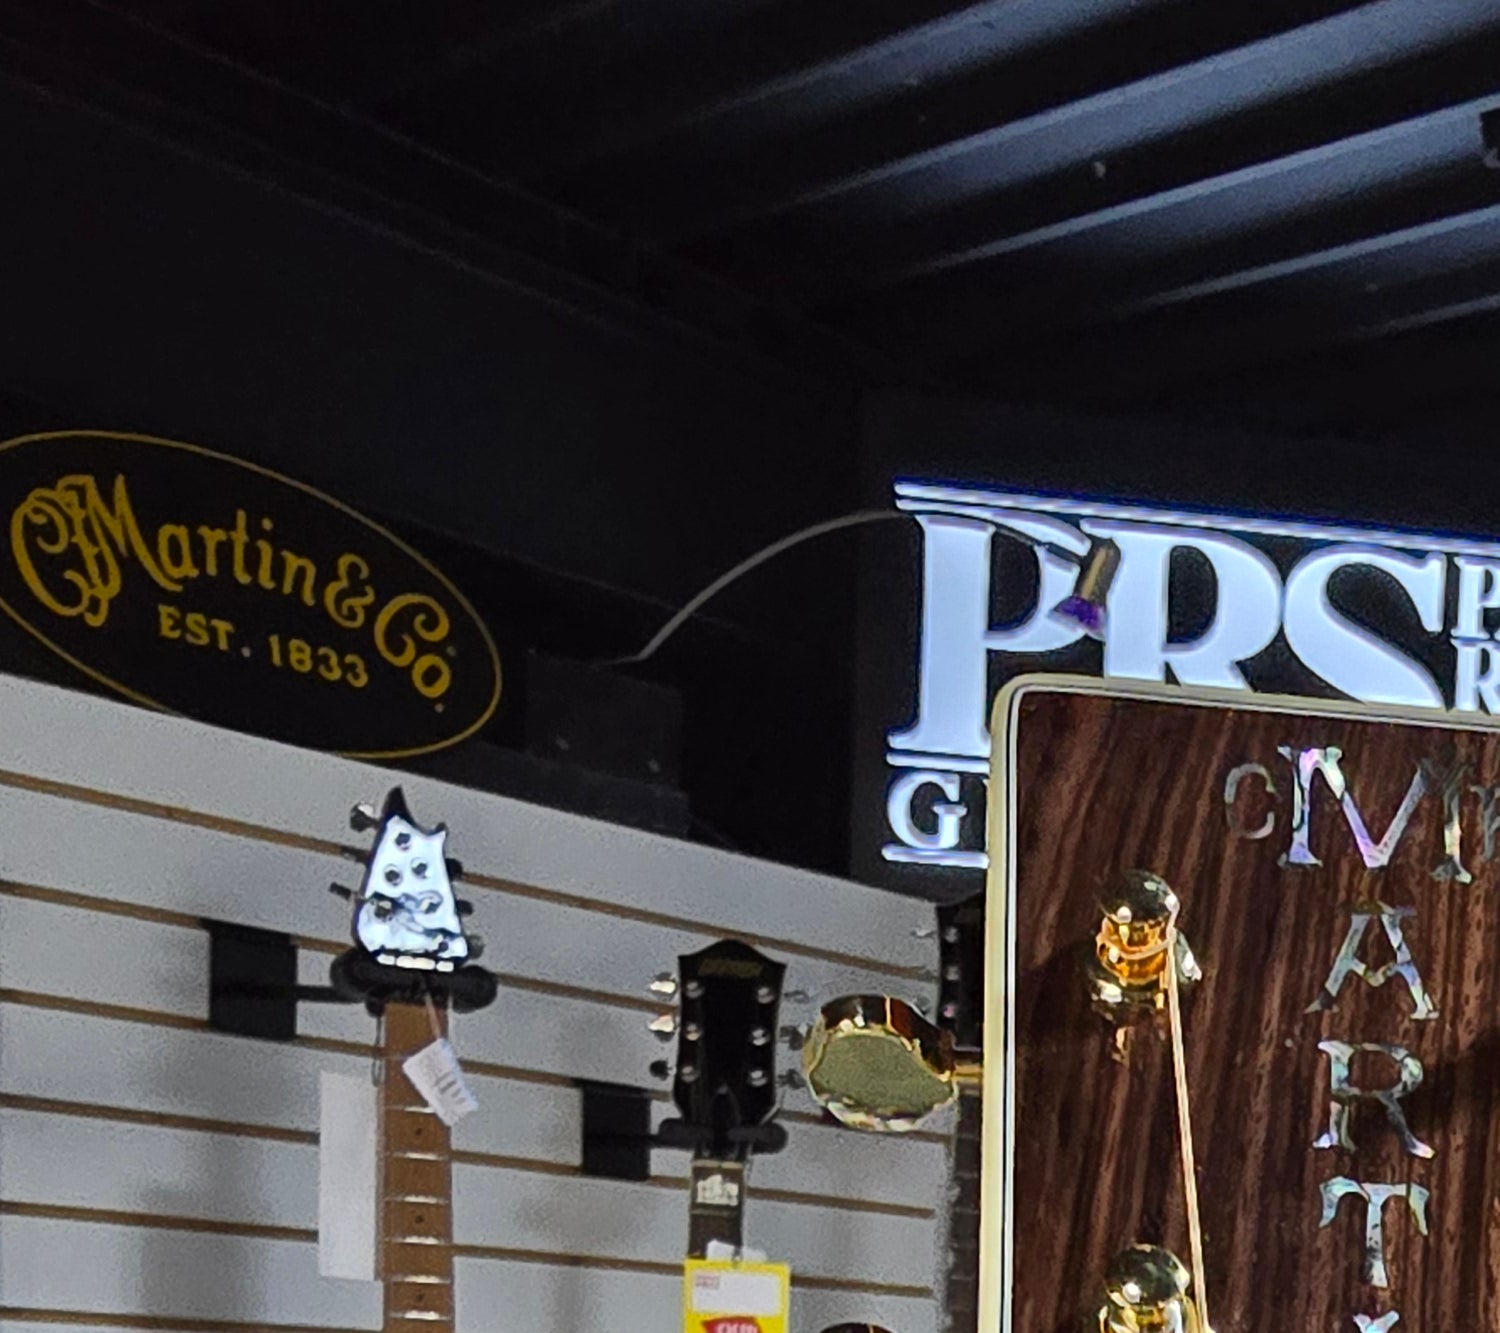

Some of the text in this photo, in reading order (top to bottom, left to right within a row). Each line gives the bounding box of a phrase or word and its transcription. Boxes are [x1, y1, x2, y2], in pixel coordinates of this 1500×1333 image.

[157, 603, 370, 690] EST. 1833
[884, 510, 1448, 762] PRS
